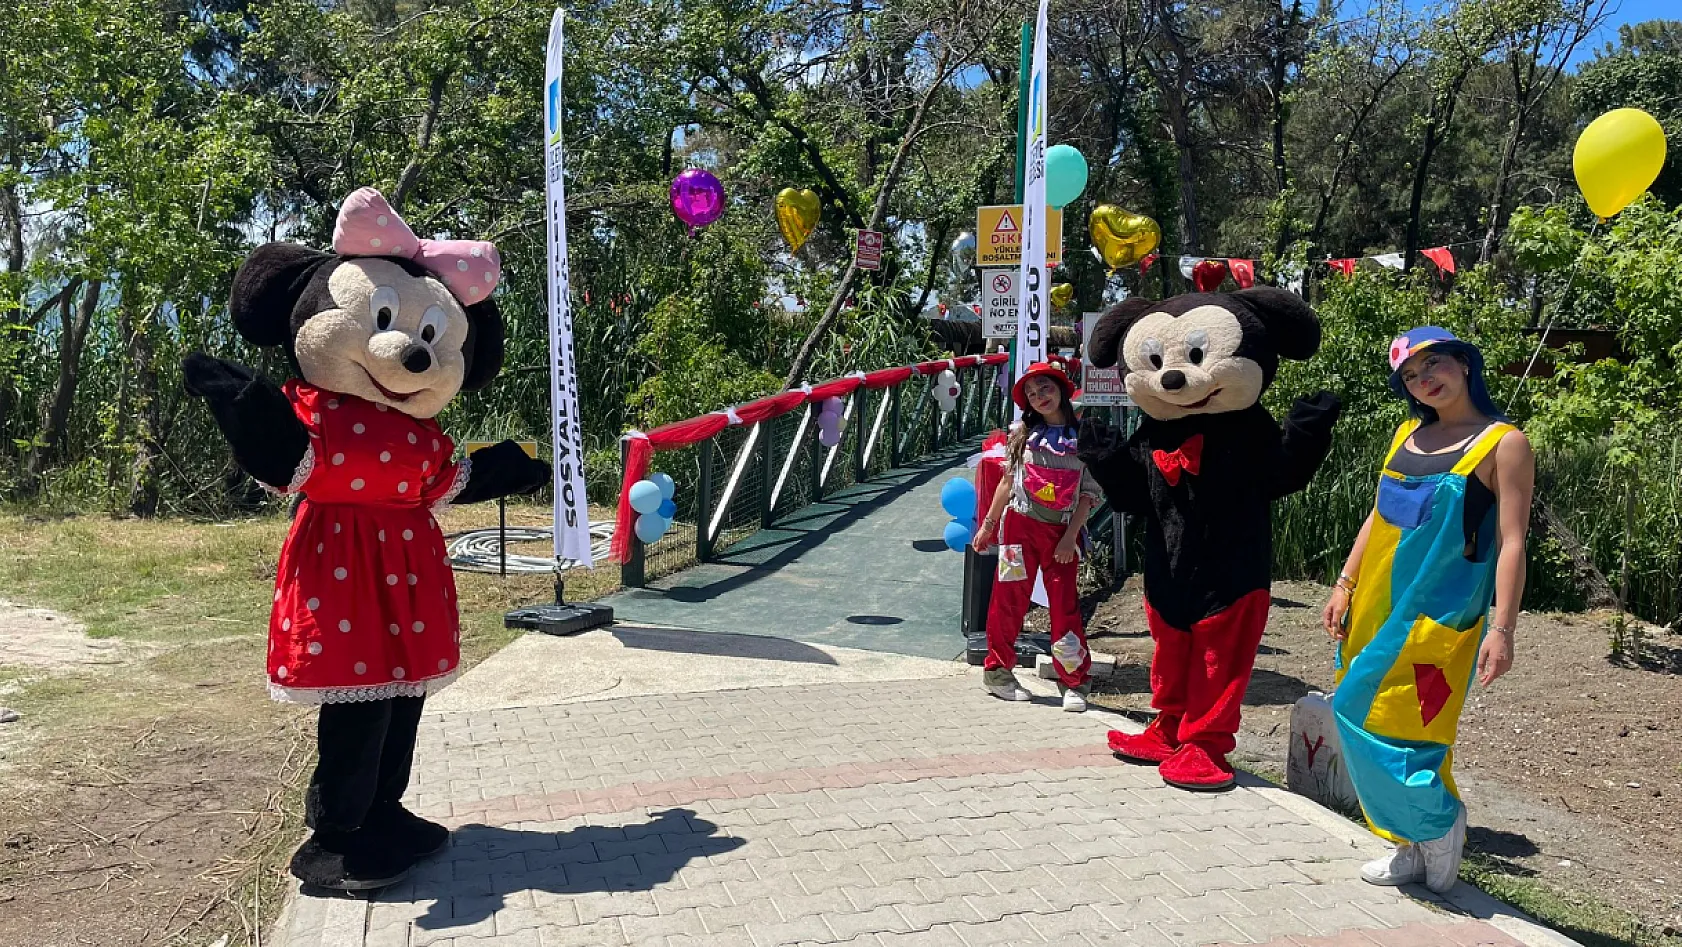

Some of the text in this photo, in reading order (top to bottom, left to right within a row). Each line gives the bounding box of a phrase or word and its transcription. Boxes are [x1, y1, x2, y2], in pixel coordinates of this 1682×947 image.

[994, 246, 1021, 254] YÜKLE
[982, 253, 1022, 262] BOŞALTM
[991, 295, 1019, 307] GİRİL
[558, 399, 578, 528] SOSYAL
